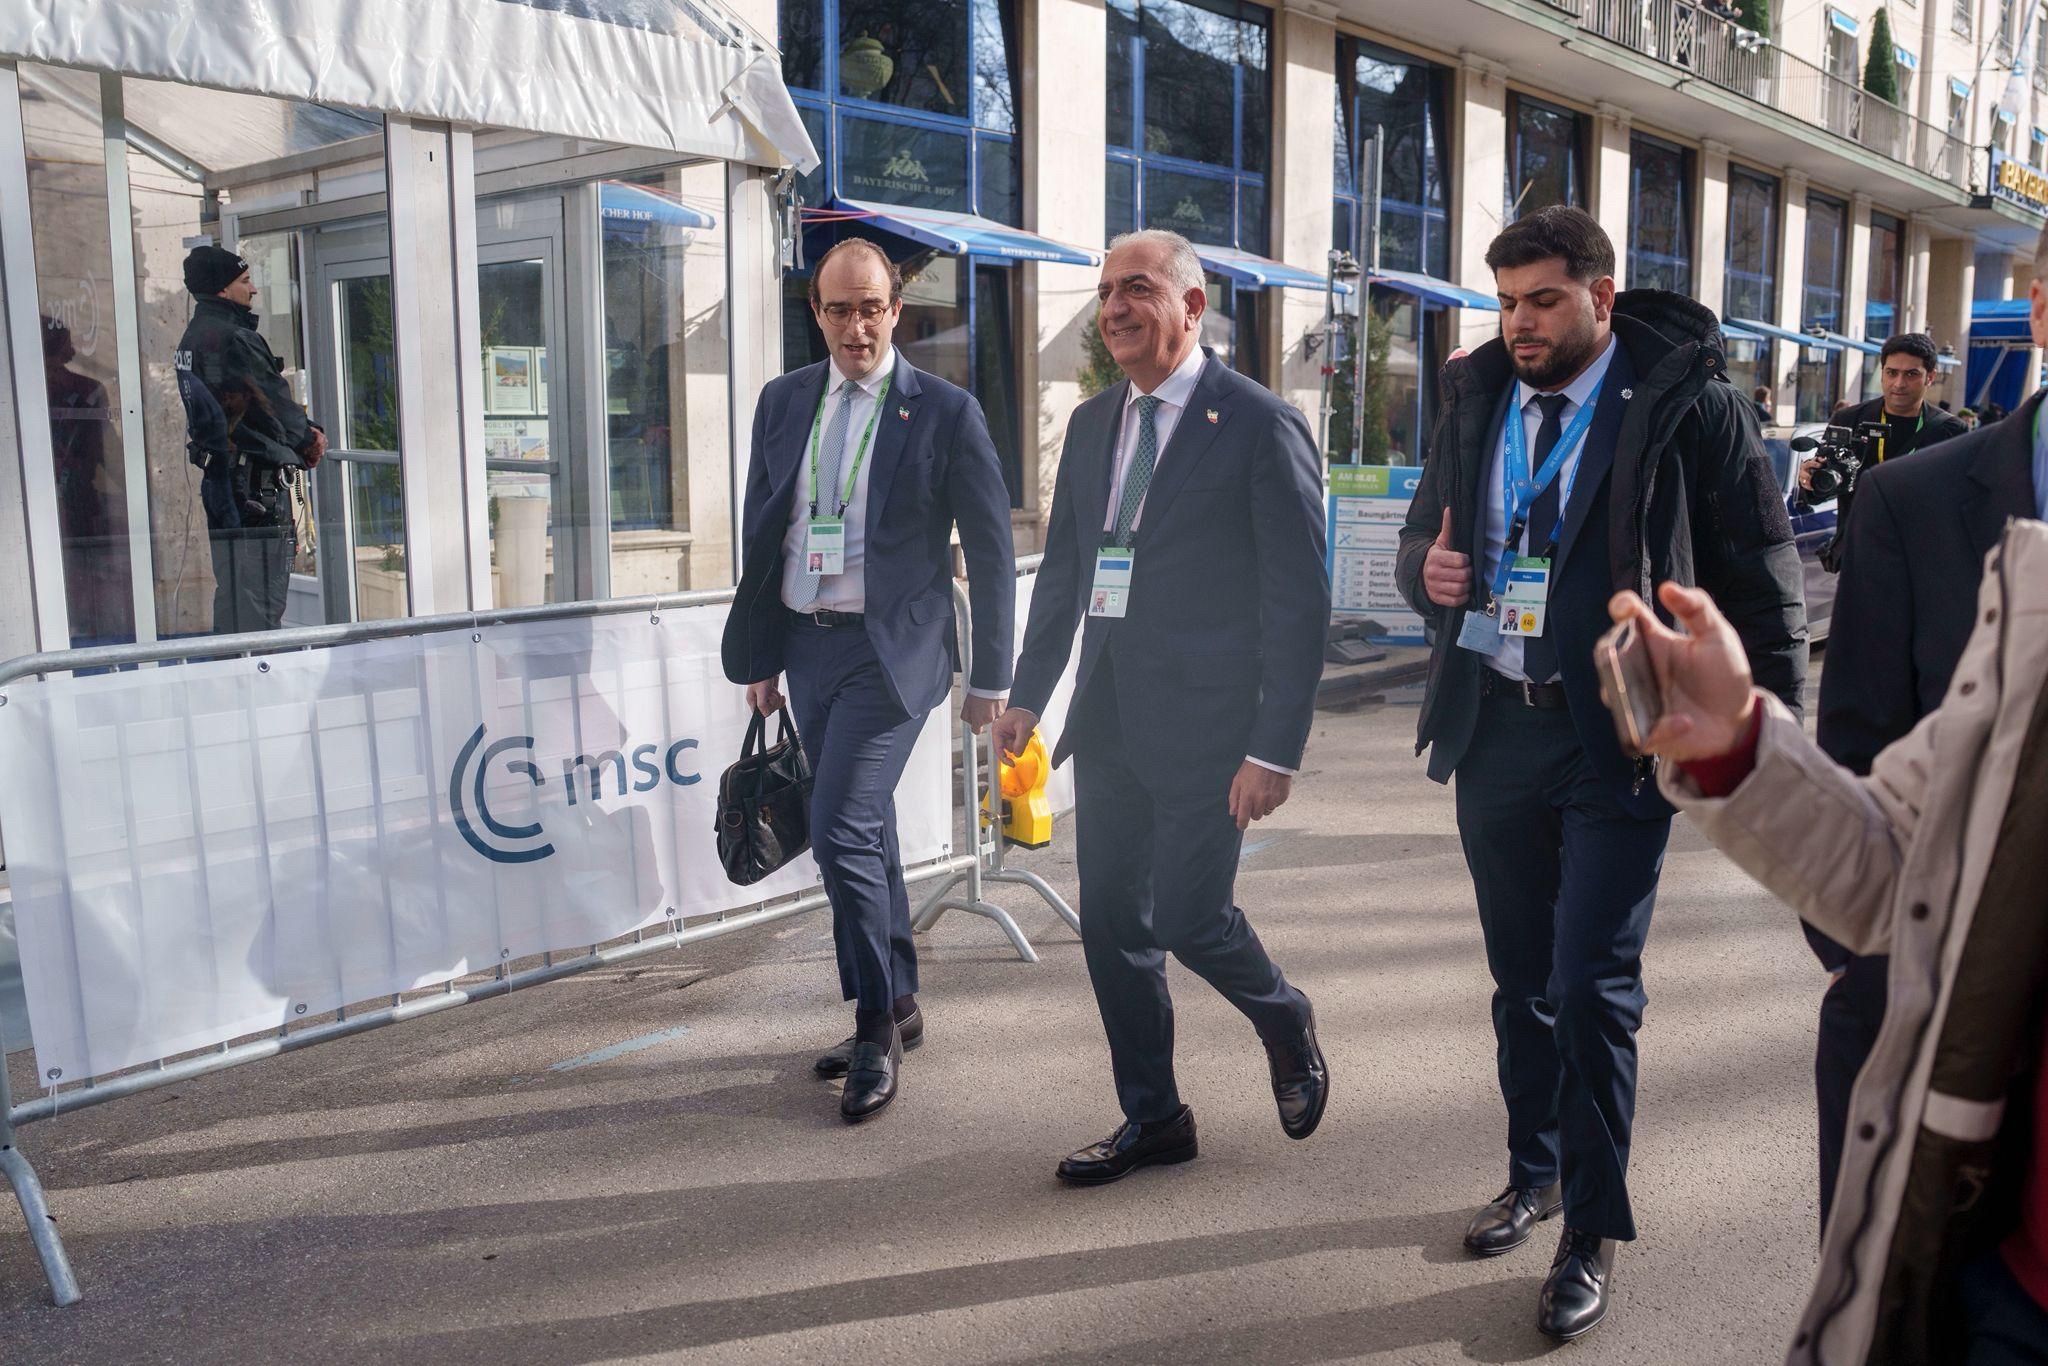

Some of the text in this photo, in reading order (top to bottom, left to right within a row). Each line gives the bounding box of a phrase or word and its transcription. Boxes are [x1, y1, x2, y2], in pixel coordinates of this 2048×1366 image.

[853, 175, 956, 197] BAYERISCHER HOF
[2000, 160, 2048, 206] BAYER
[632, 210, 653, 220] HOF
[1338, 472, 1352, 482] AM
[1403, 479, 1421, 490] CS
[1358, 509, 1406, 520] Baumgärtne
[563, 738, 702, 806] msc
